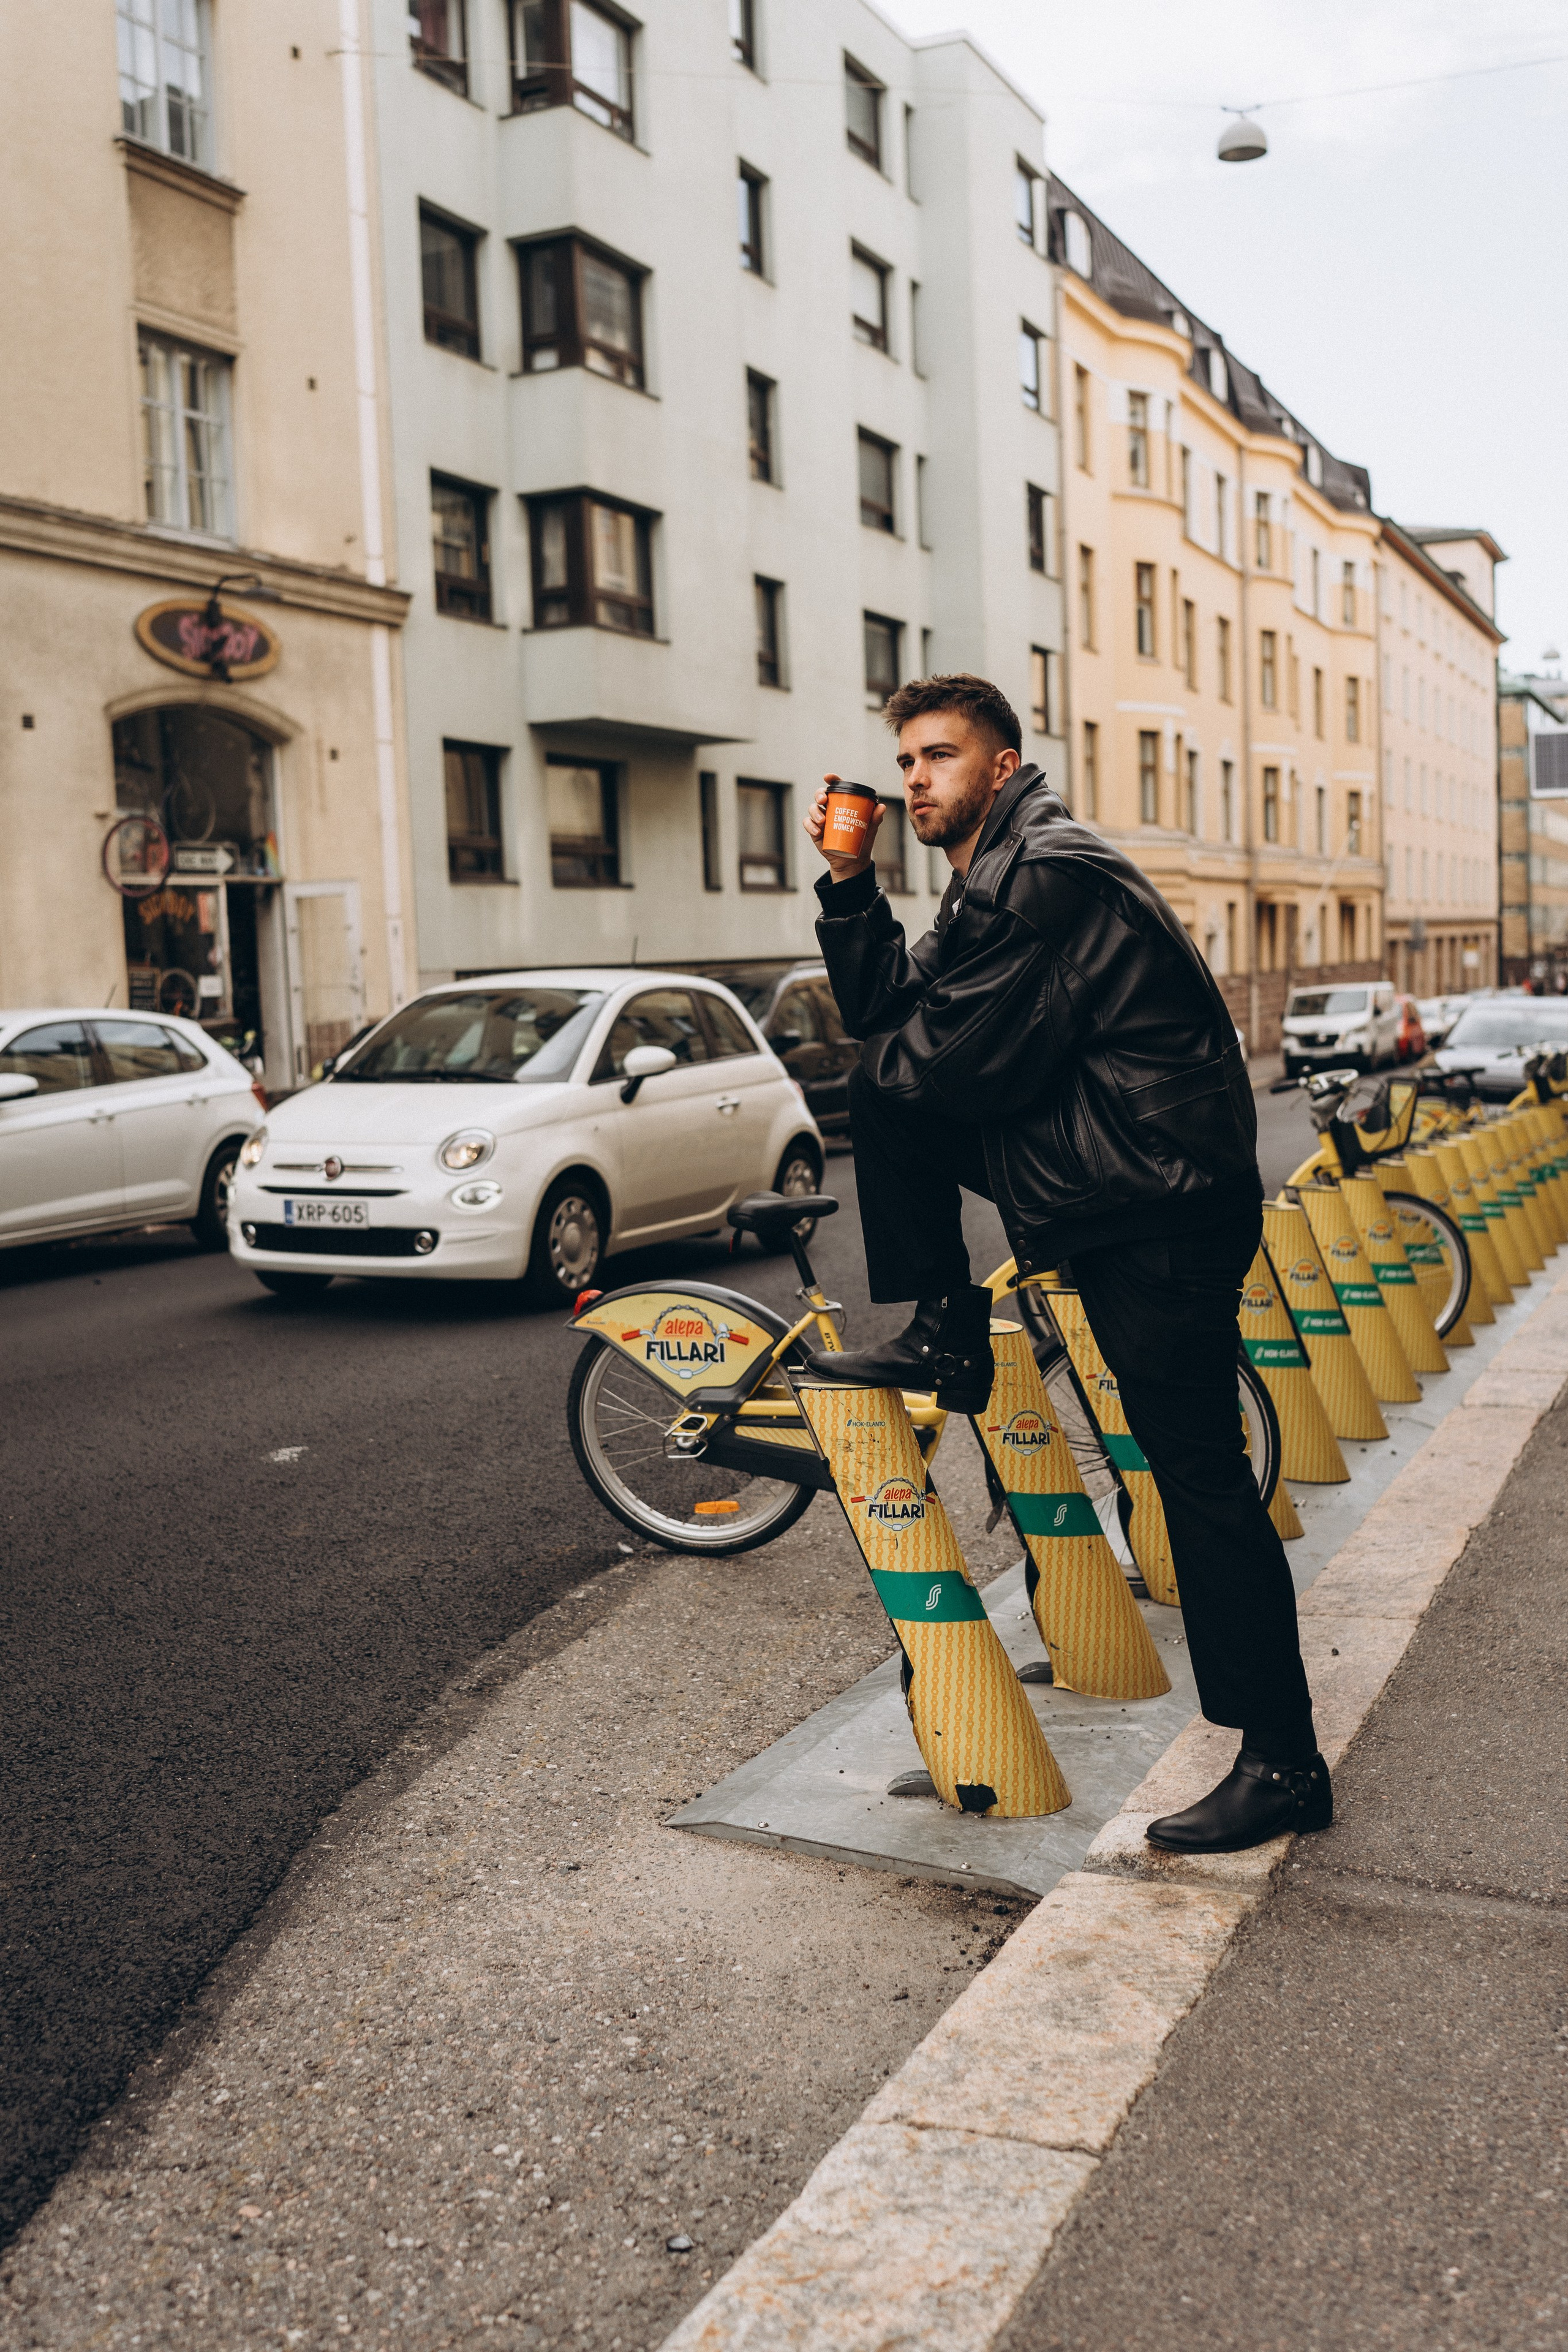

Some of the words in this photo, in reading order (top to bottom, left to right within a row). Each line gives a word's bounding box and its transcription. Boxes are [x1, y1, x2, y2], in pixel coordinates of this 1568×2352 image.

[835, 807, 859, 818] COFFEE
[833, 822, 854, 833] WOMEN
[296, 1204, 363, 1223] XRP-605
[665, 1318, 703, 1337] alepa
[646, 1341, 725, 1363] FILLARI
[1016, 1418, 1039, 1431] alepa
[1002, 1431, 1050, 1446] FILLARI
[883, 1487, 912, 1502] alepa
[867, 1503, 925, 1519] FILLARI
